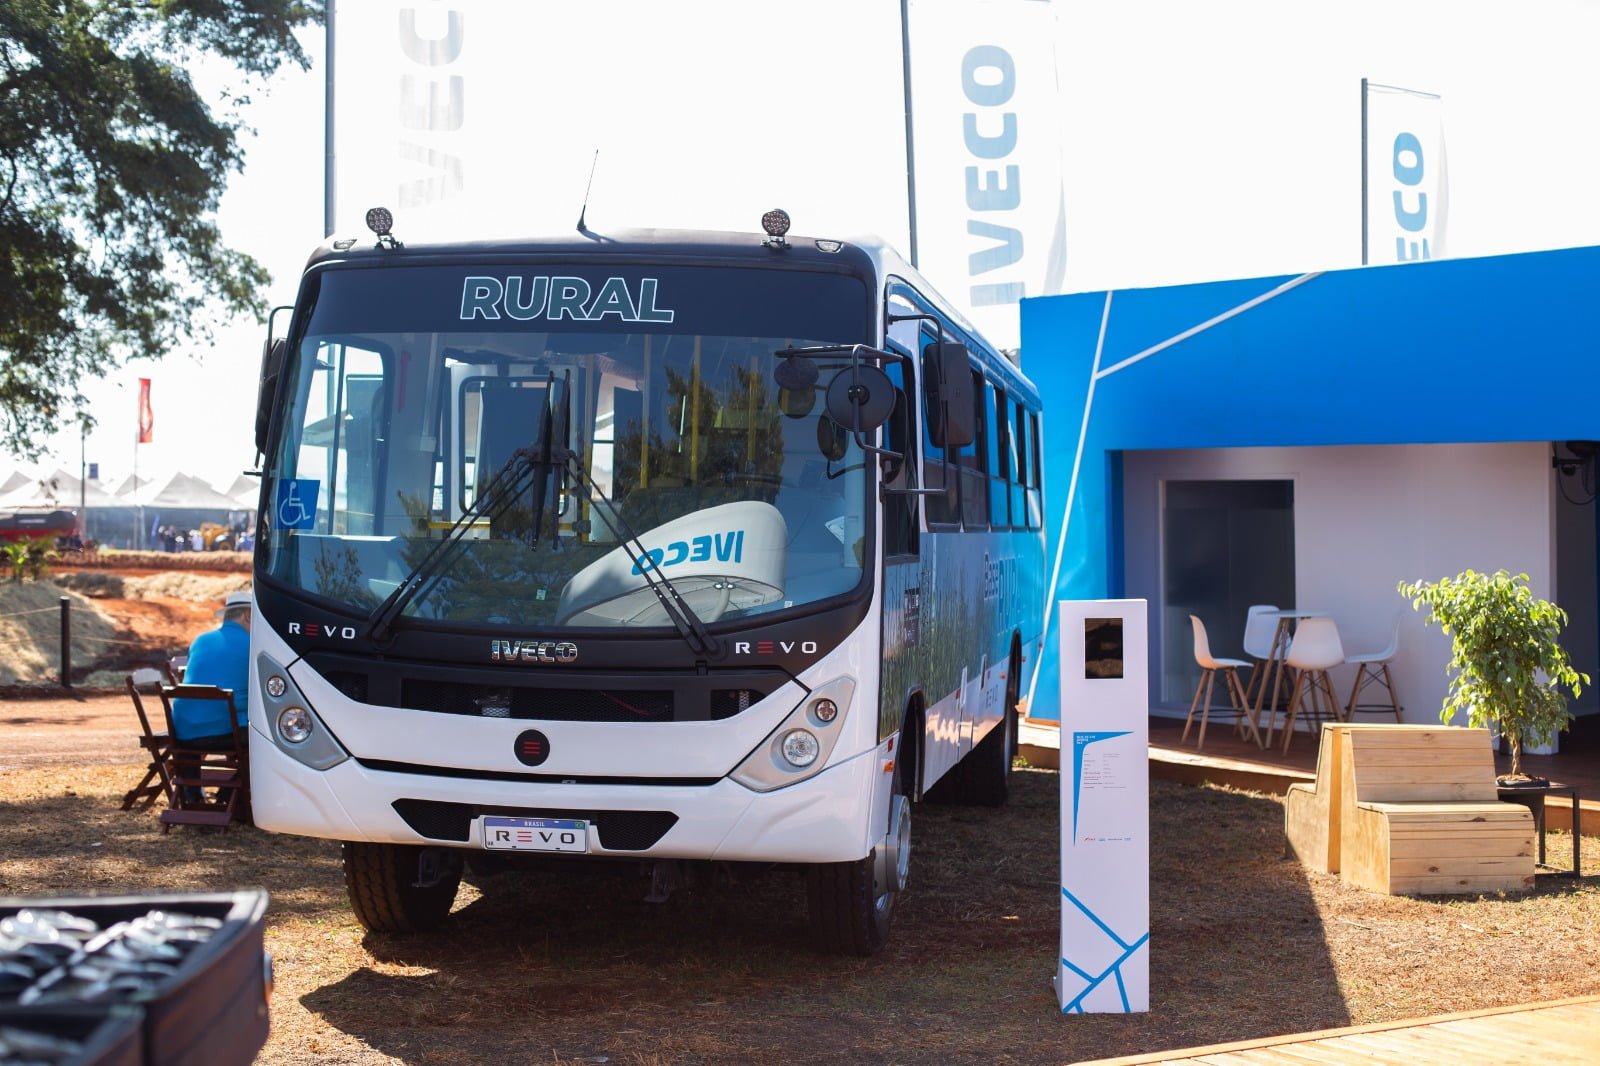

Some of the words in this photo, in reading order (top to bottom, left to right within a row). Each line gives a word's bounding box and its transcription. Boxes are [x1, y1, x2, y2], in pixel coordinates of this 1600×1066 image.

[398, 0, 464, 209] VEC
[961, 45, 1025, 307] IVECO
[460, 276, 674, 322] RURAL
[288, 622, 356, 640] REVO
[491, 640, 578, 662] IVECO
[735, 641, 817, 654] REVO
[495, 830, 575, 844] REVO
